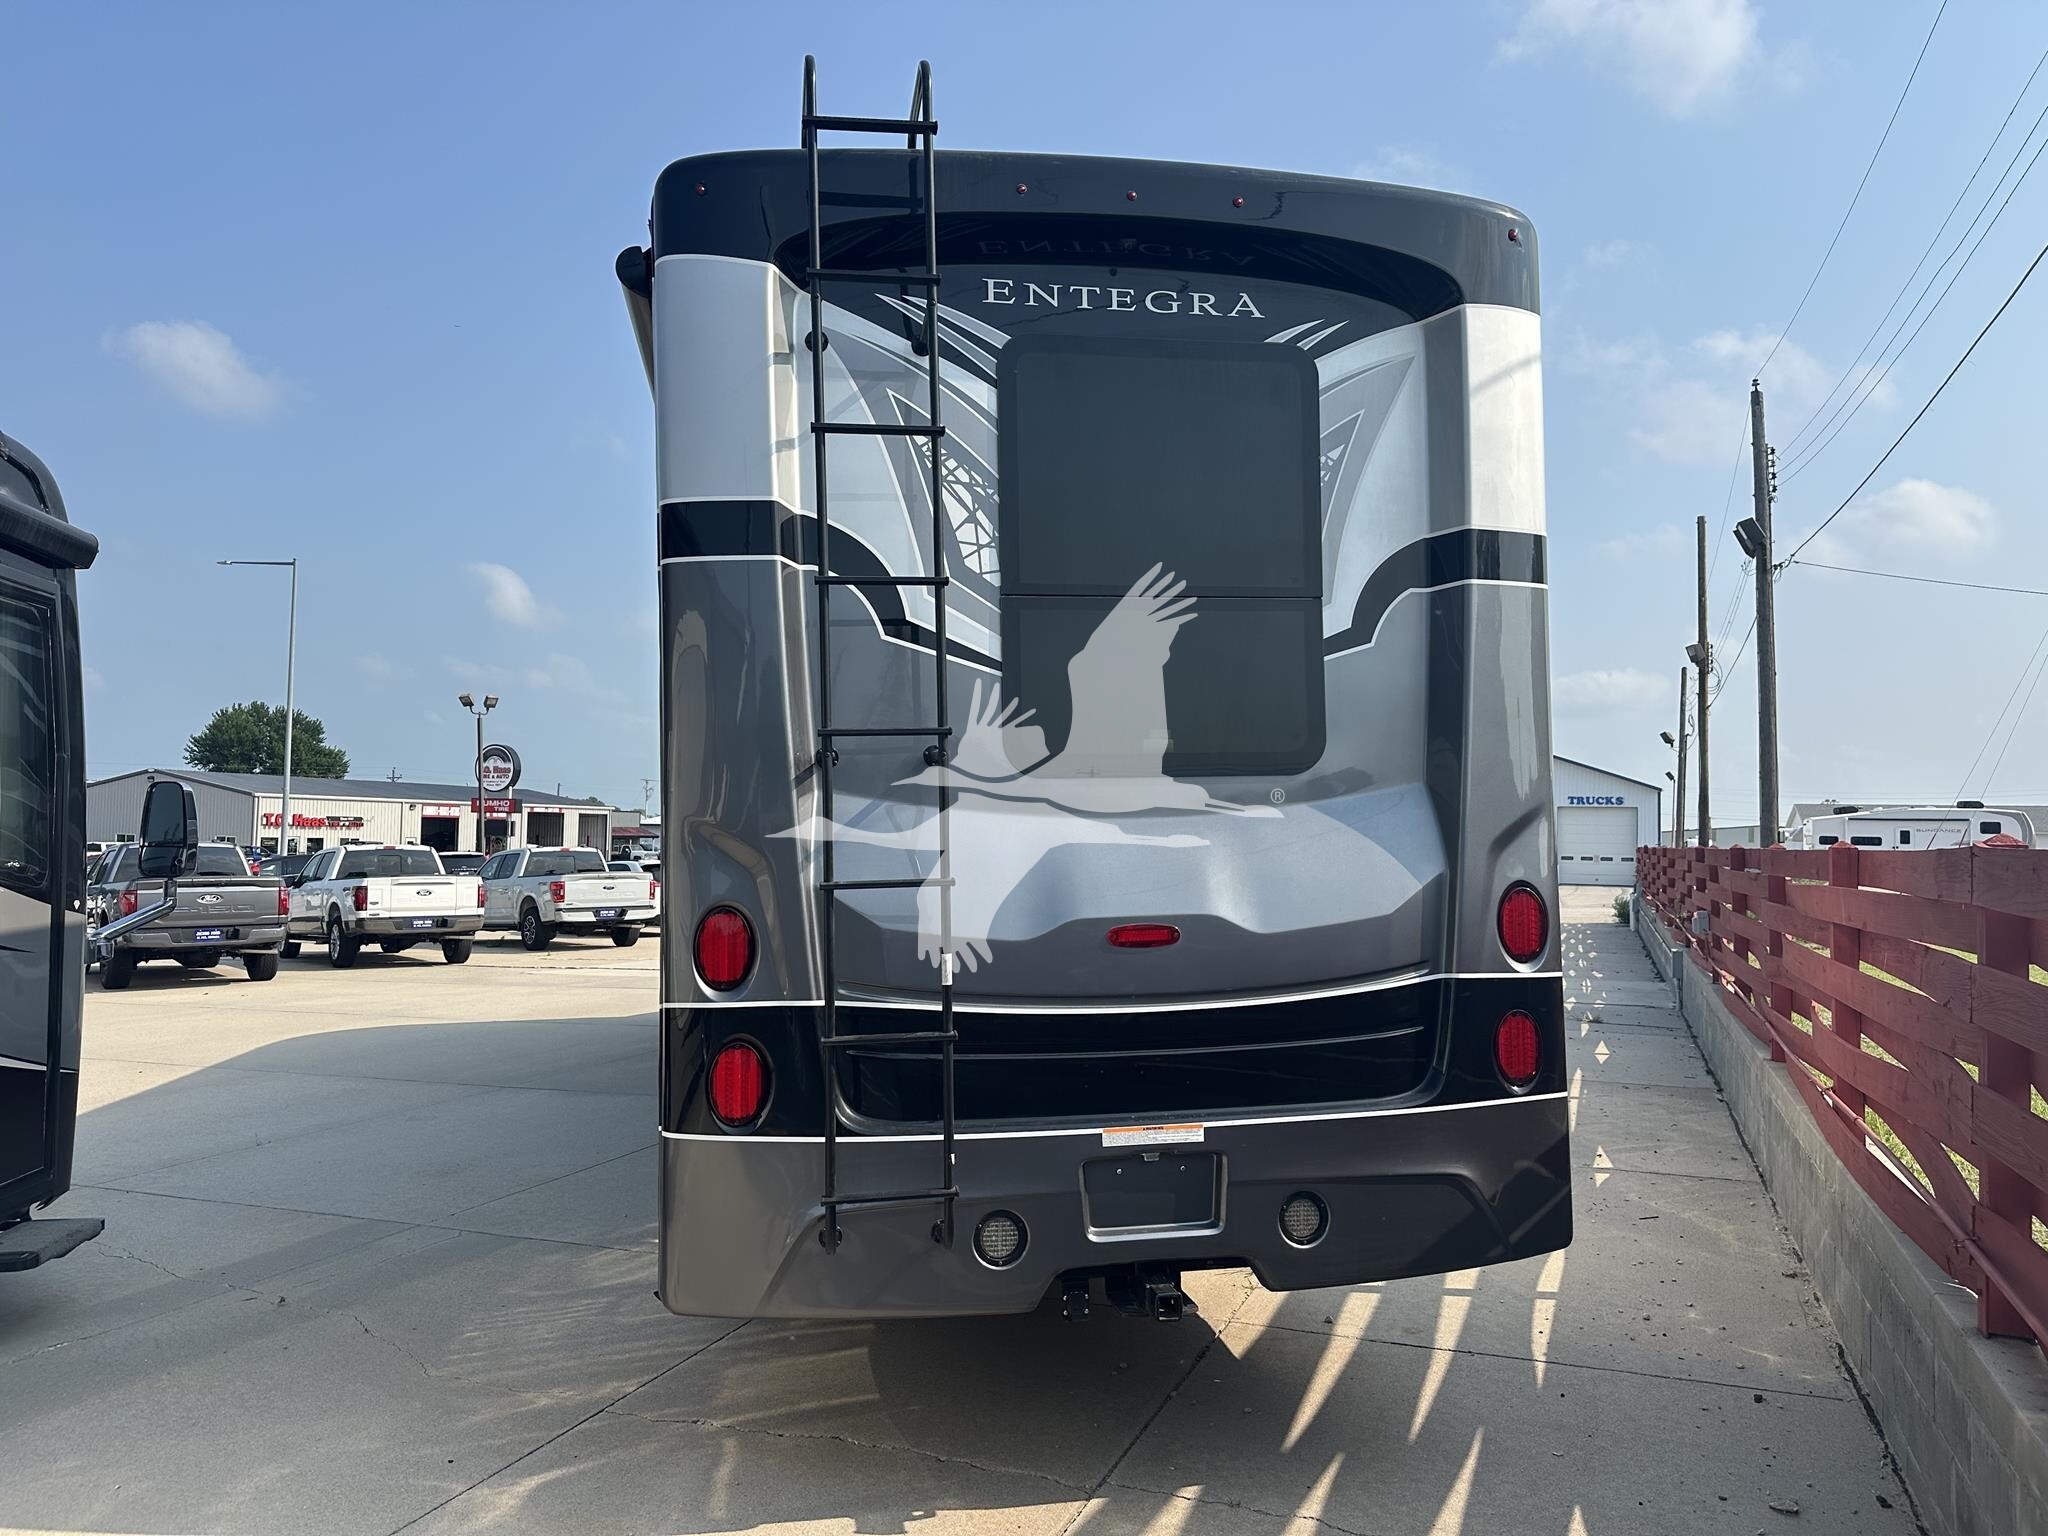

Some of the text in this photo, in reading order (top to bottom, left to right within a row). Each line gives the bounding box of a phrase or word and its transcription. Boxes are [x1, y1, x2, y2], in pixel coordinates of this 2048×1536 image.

[981, 277, 1266, 319] ENTEGRA
[1567, 796, 1624, 806] TRUCKS
[292, 813, 326, 827] Haas
